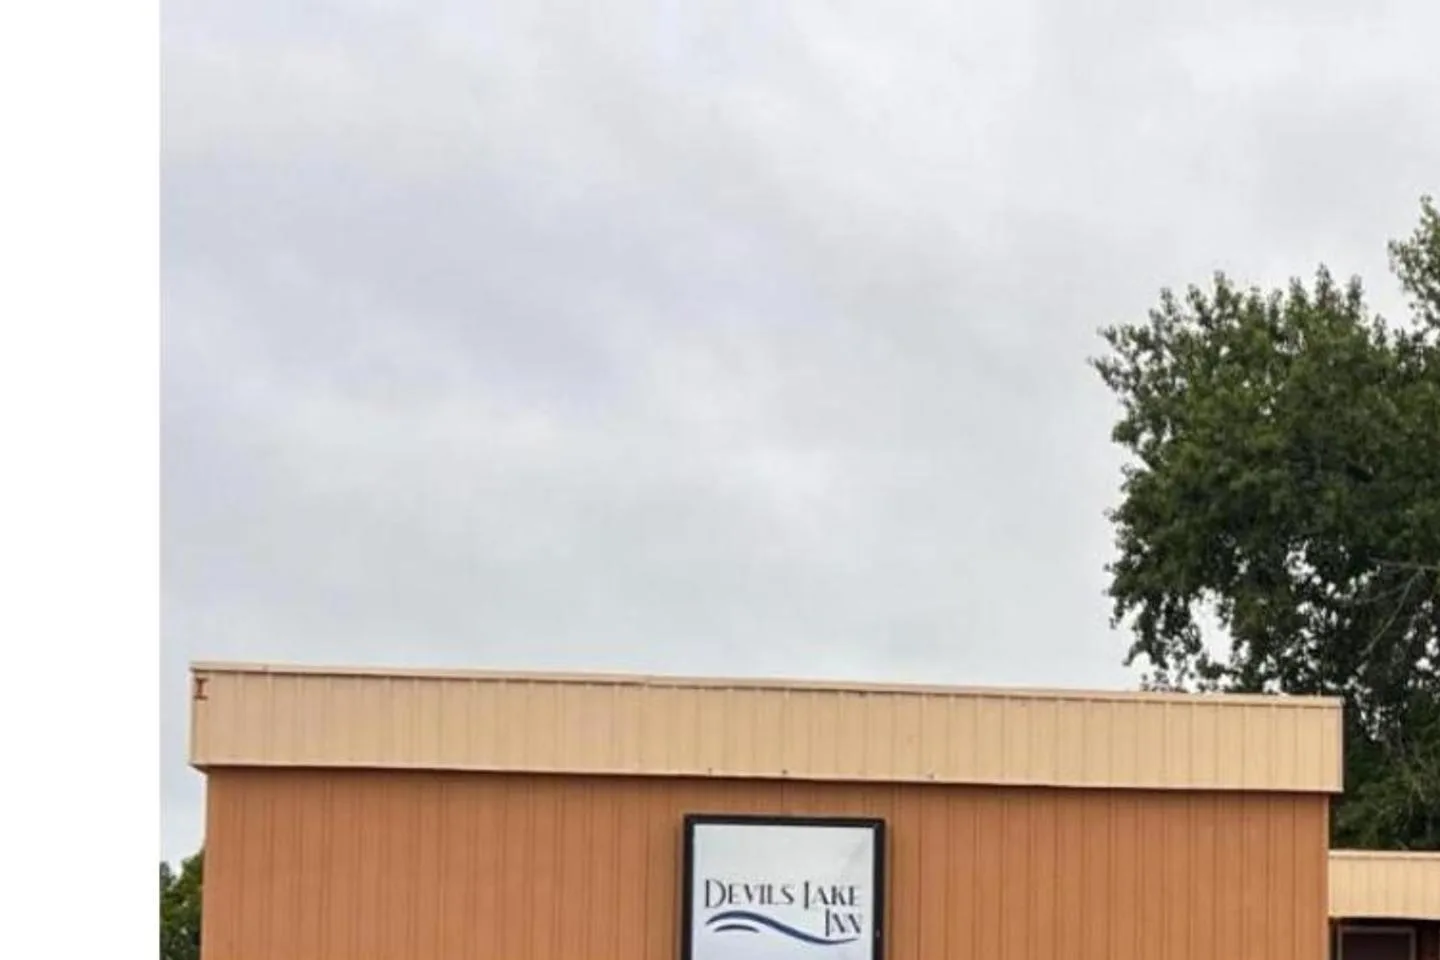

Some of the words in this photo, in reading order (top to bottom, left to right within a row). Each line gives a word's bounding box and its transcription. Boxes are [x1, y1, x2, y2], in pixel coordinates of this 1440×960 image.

[704, 879, 796, 909] DEVILS
[803, 880, 862, 910] LAKE
[825, 908, 863, 937] INN
